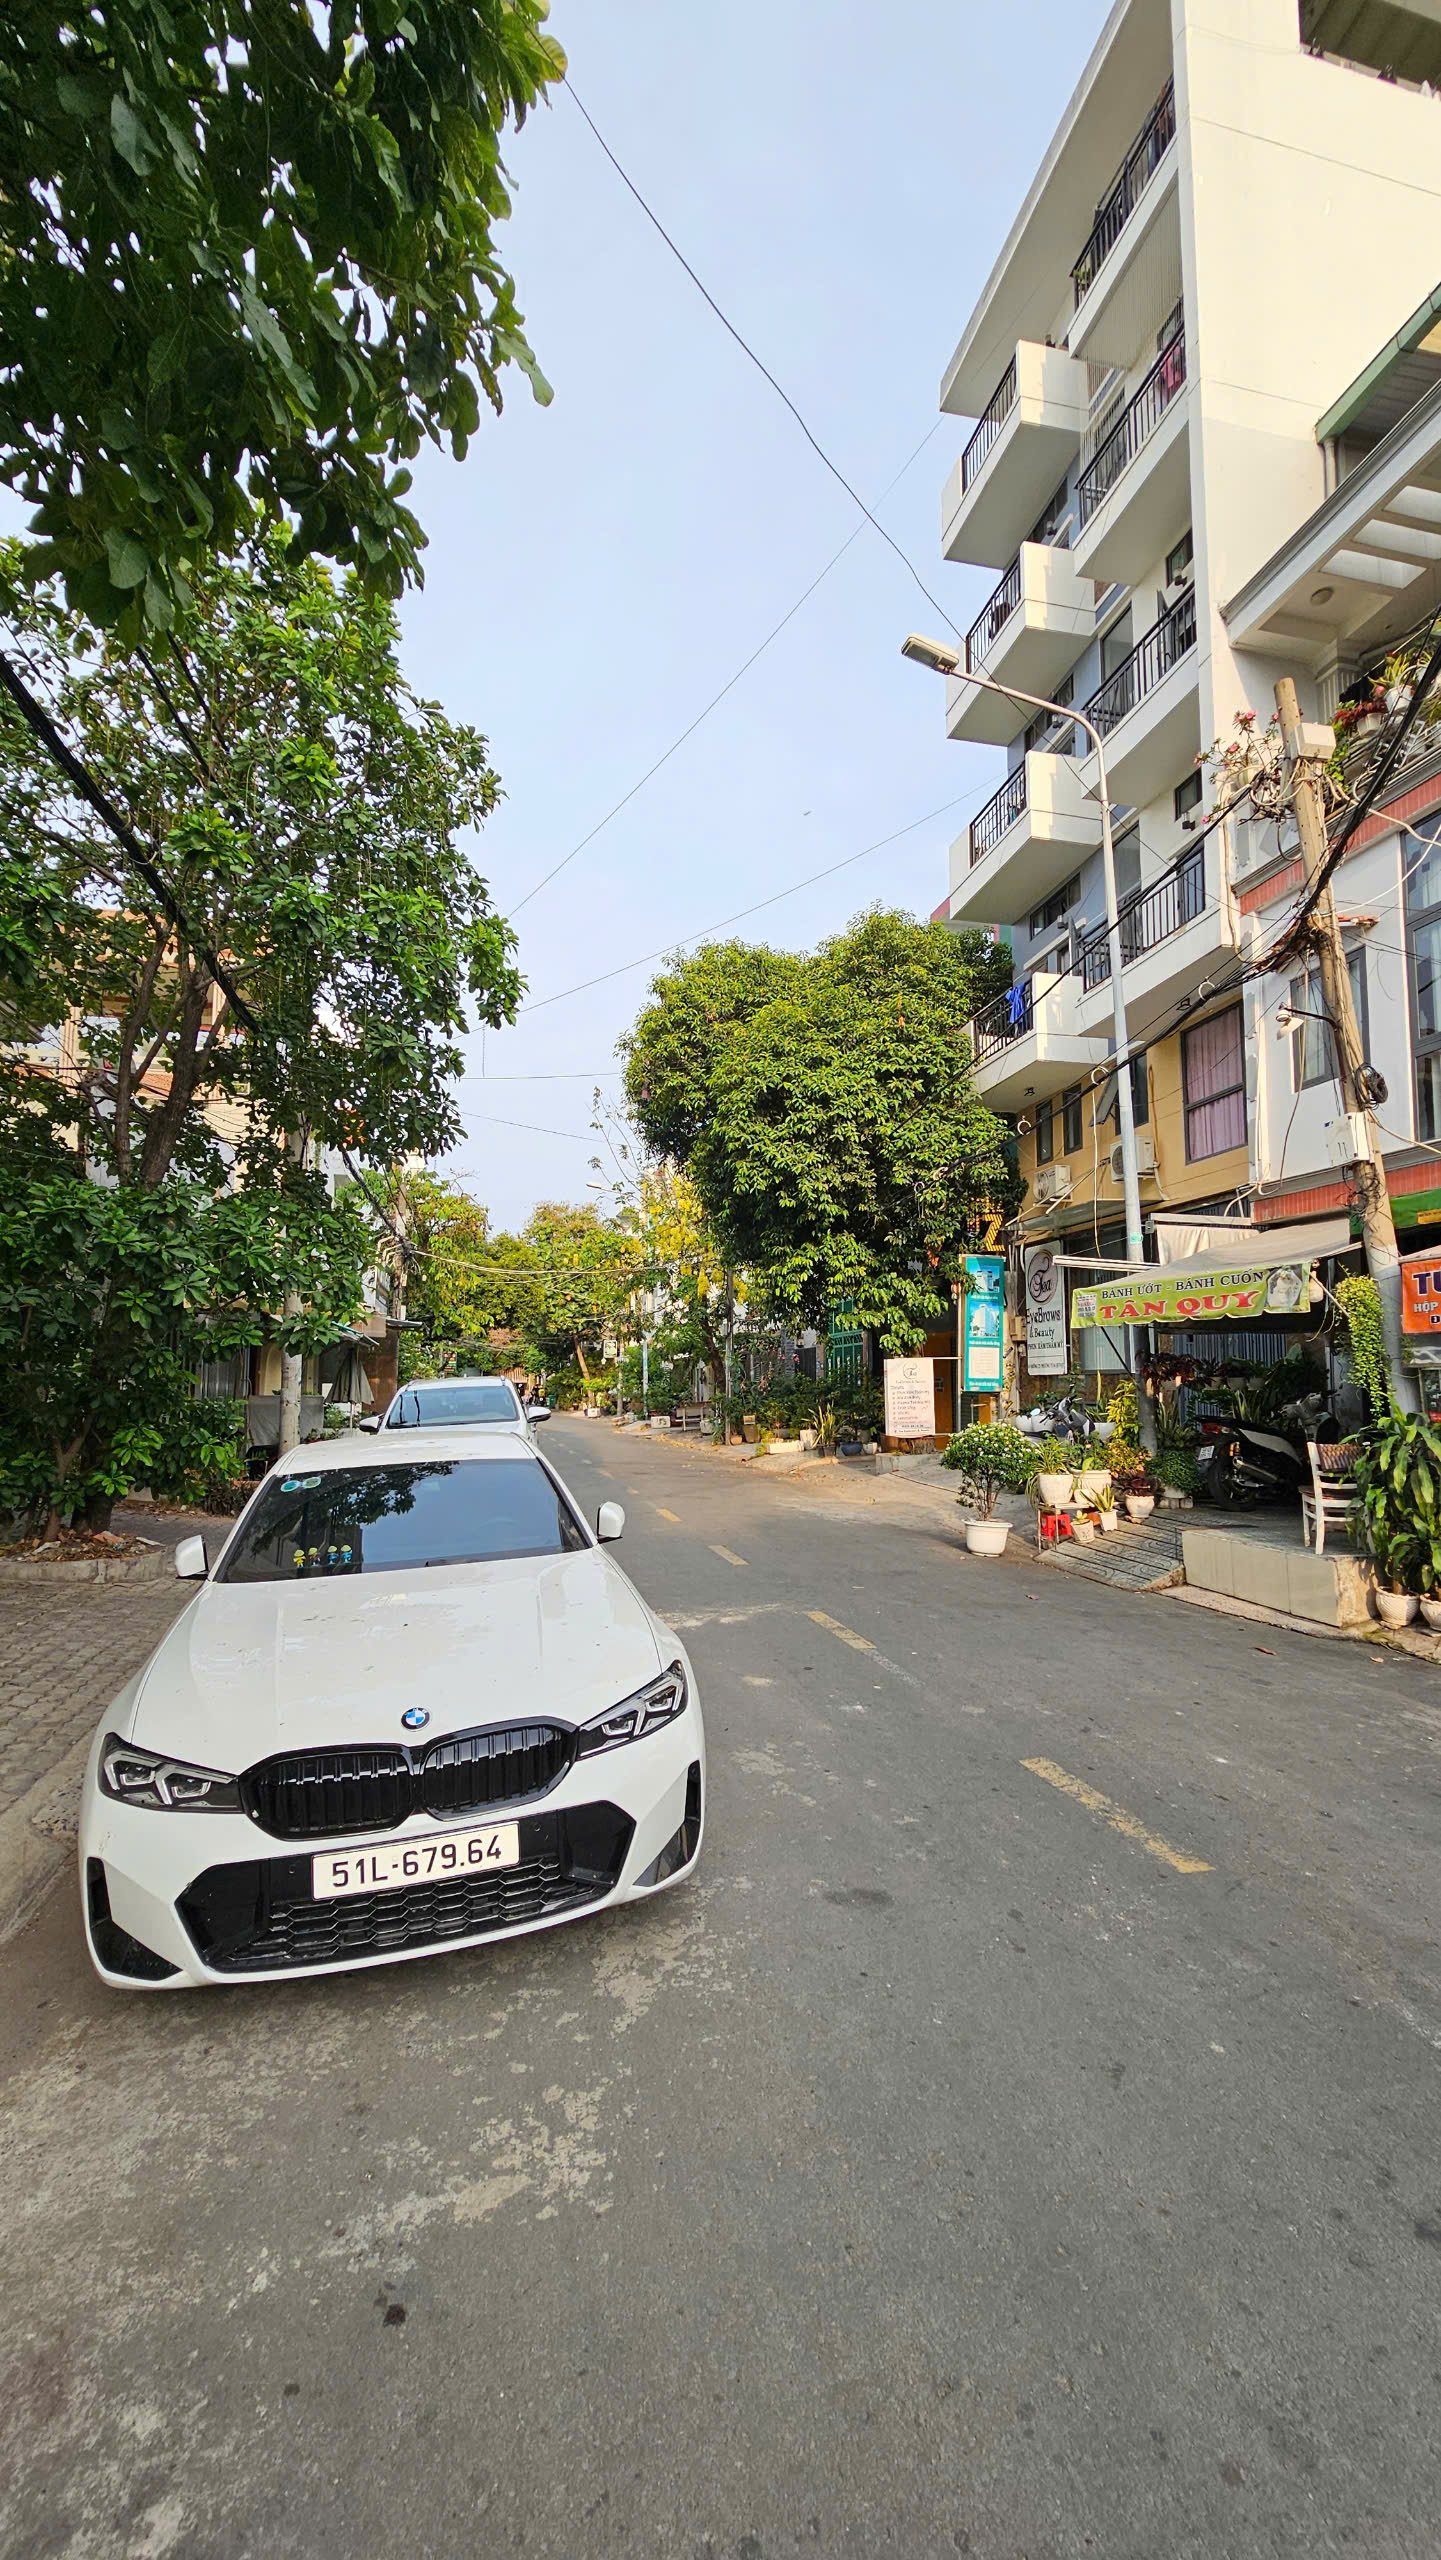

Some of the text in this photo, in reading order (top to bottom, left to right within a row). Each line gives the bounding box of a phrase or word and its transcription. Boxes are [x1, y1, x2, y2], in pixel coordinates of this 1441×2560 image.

[1102, 1287, 1133, 1299] BÁNH
[1137, 1283, 1162, 1295] ƯỚT
[1175, 1277, 1215, 1291] BÁNH
[1220, 1268, 1264, 1286] CUỐN
[1026, 1307, 1061, 1325] EyeBrows
[1098, 1290, 1262, 1319] TÂN QUY
[1413, 1300, 1439, 1313] HỘP
[1034, 1327, 1055, 1340] Beauty
[332, 1834, 502, 1888] 51L-679.64
